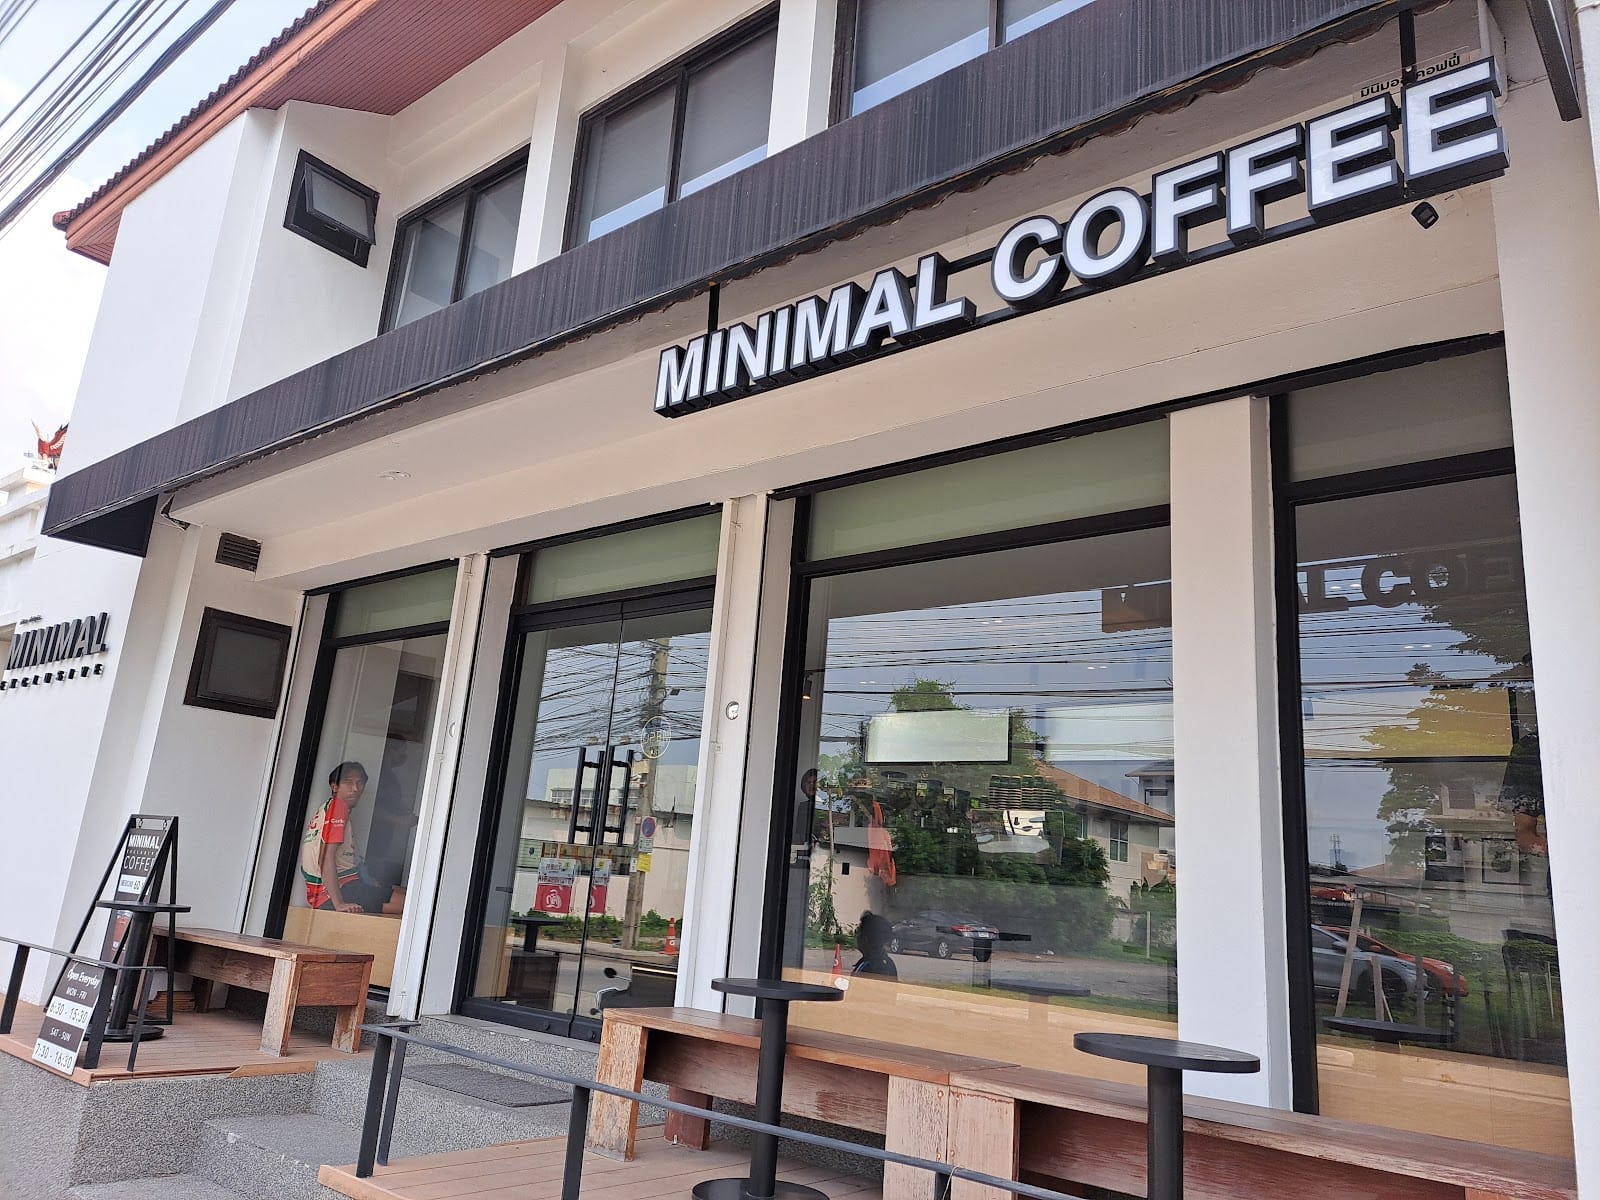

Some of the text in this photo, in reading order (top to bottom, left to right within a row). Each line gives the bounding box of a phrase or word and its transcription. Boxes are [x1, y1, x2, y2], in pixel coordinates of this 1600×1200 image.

[1360, 77, 1405, 98] มินิมอ
[653, 56, 1508, 418] MINIMAL COFFEE
[4, 612, 108, 670] MINIMAL
[128, 834, 160, 849] MINIMAL
[67, 968, 101, 989] Open Everyday
[66, 987, 77, 997] MON
[79, 990, 88, 1000] FRI
[69, 1007, 88, 1023] 15:30
[50, 1027, 60, 1037] SAT
[61, 1031, 71, 1042] SUN
[35, 1043, 50, 1059] 7:30
[54, 1051, 73, 1069] 16:30
